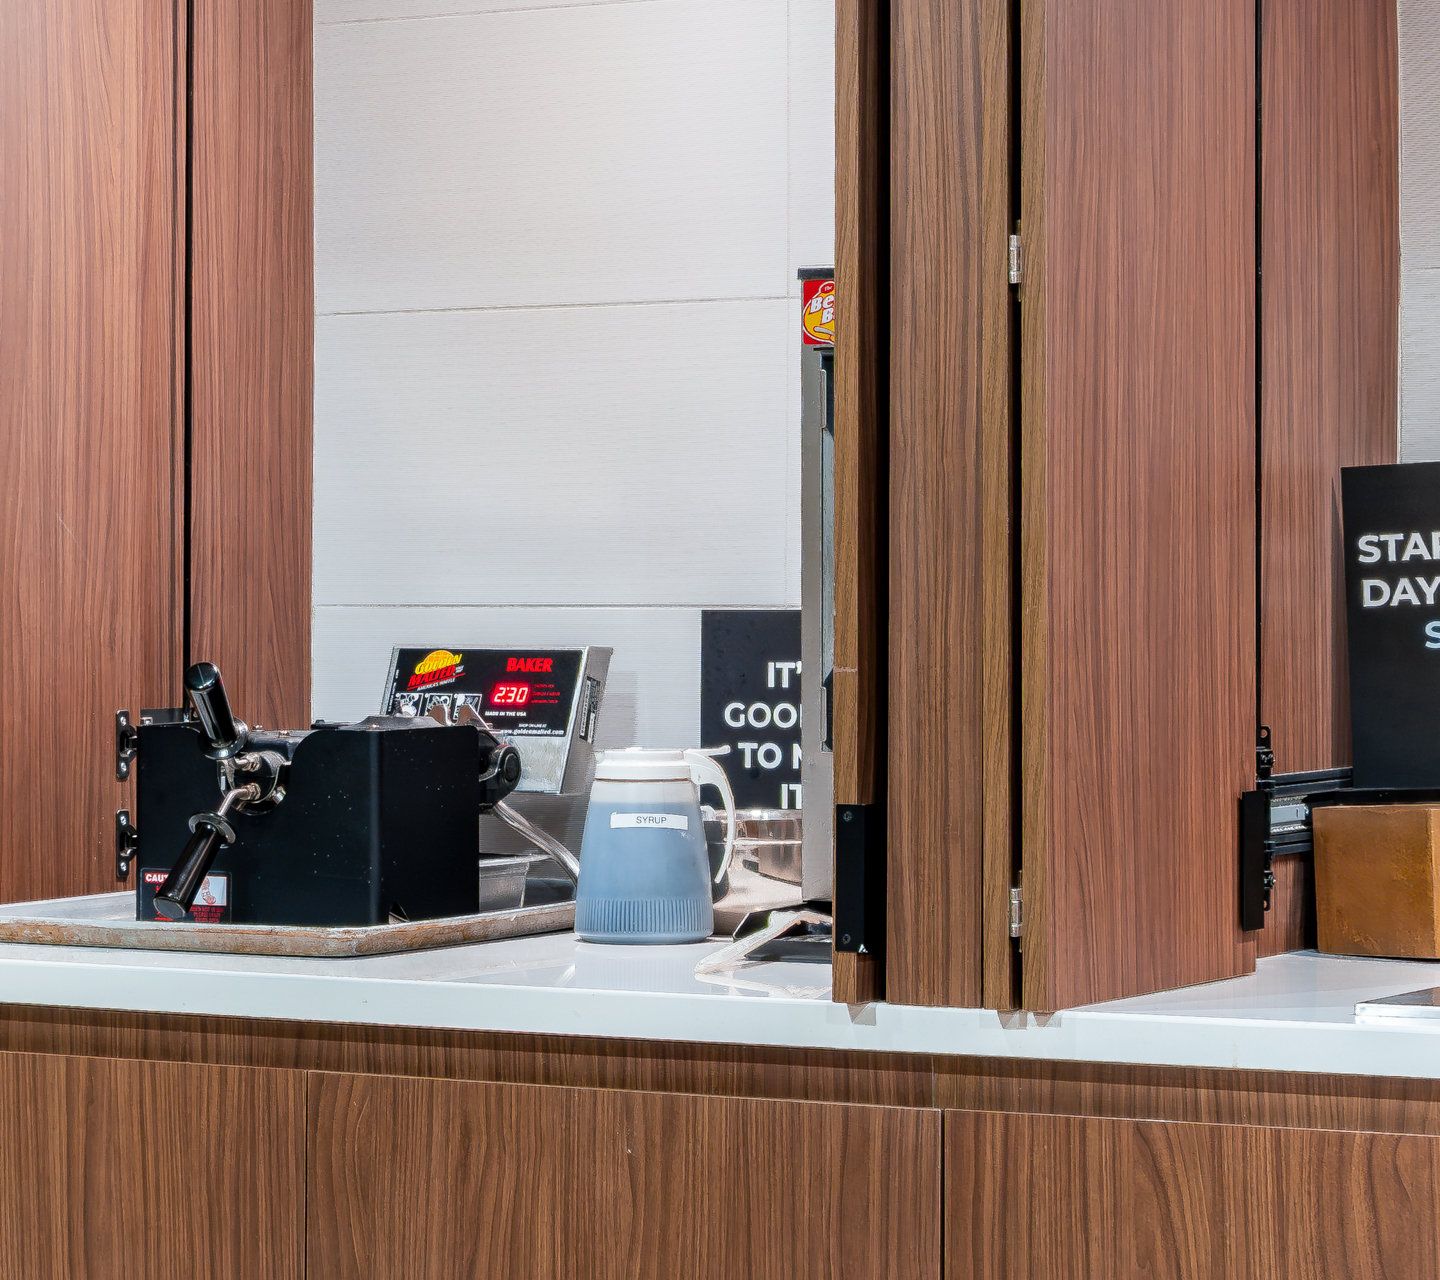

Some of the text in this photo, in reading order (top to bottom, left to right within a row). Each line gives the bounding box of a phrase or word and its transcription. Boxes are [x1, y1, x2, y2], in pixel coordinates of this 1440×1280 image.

[408, 664, 456, 687] MALTED
[506, 657, 553, 672] BAKER
[767, 660, 802, 688] IT'
[724, 702, 802, 729] GOO
[737, 742, 782, 769] TO
[636, 816, 667, 824] SYRUP
[145, 873, 169, 882] CAUT
